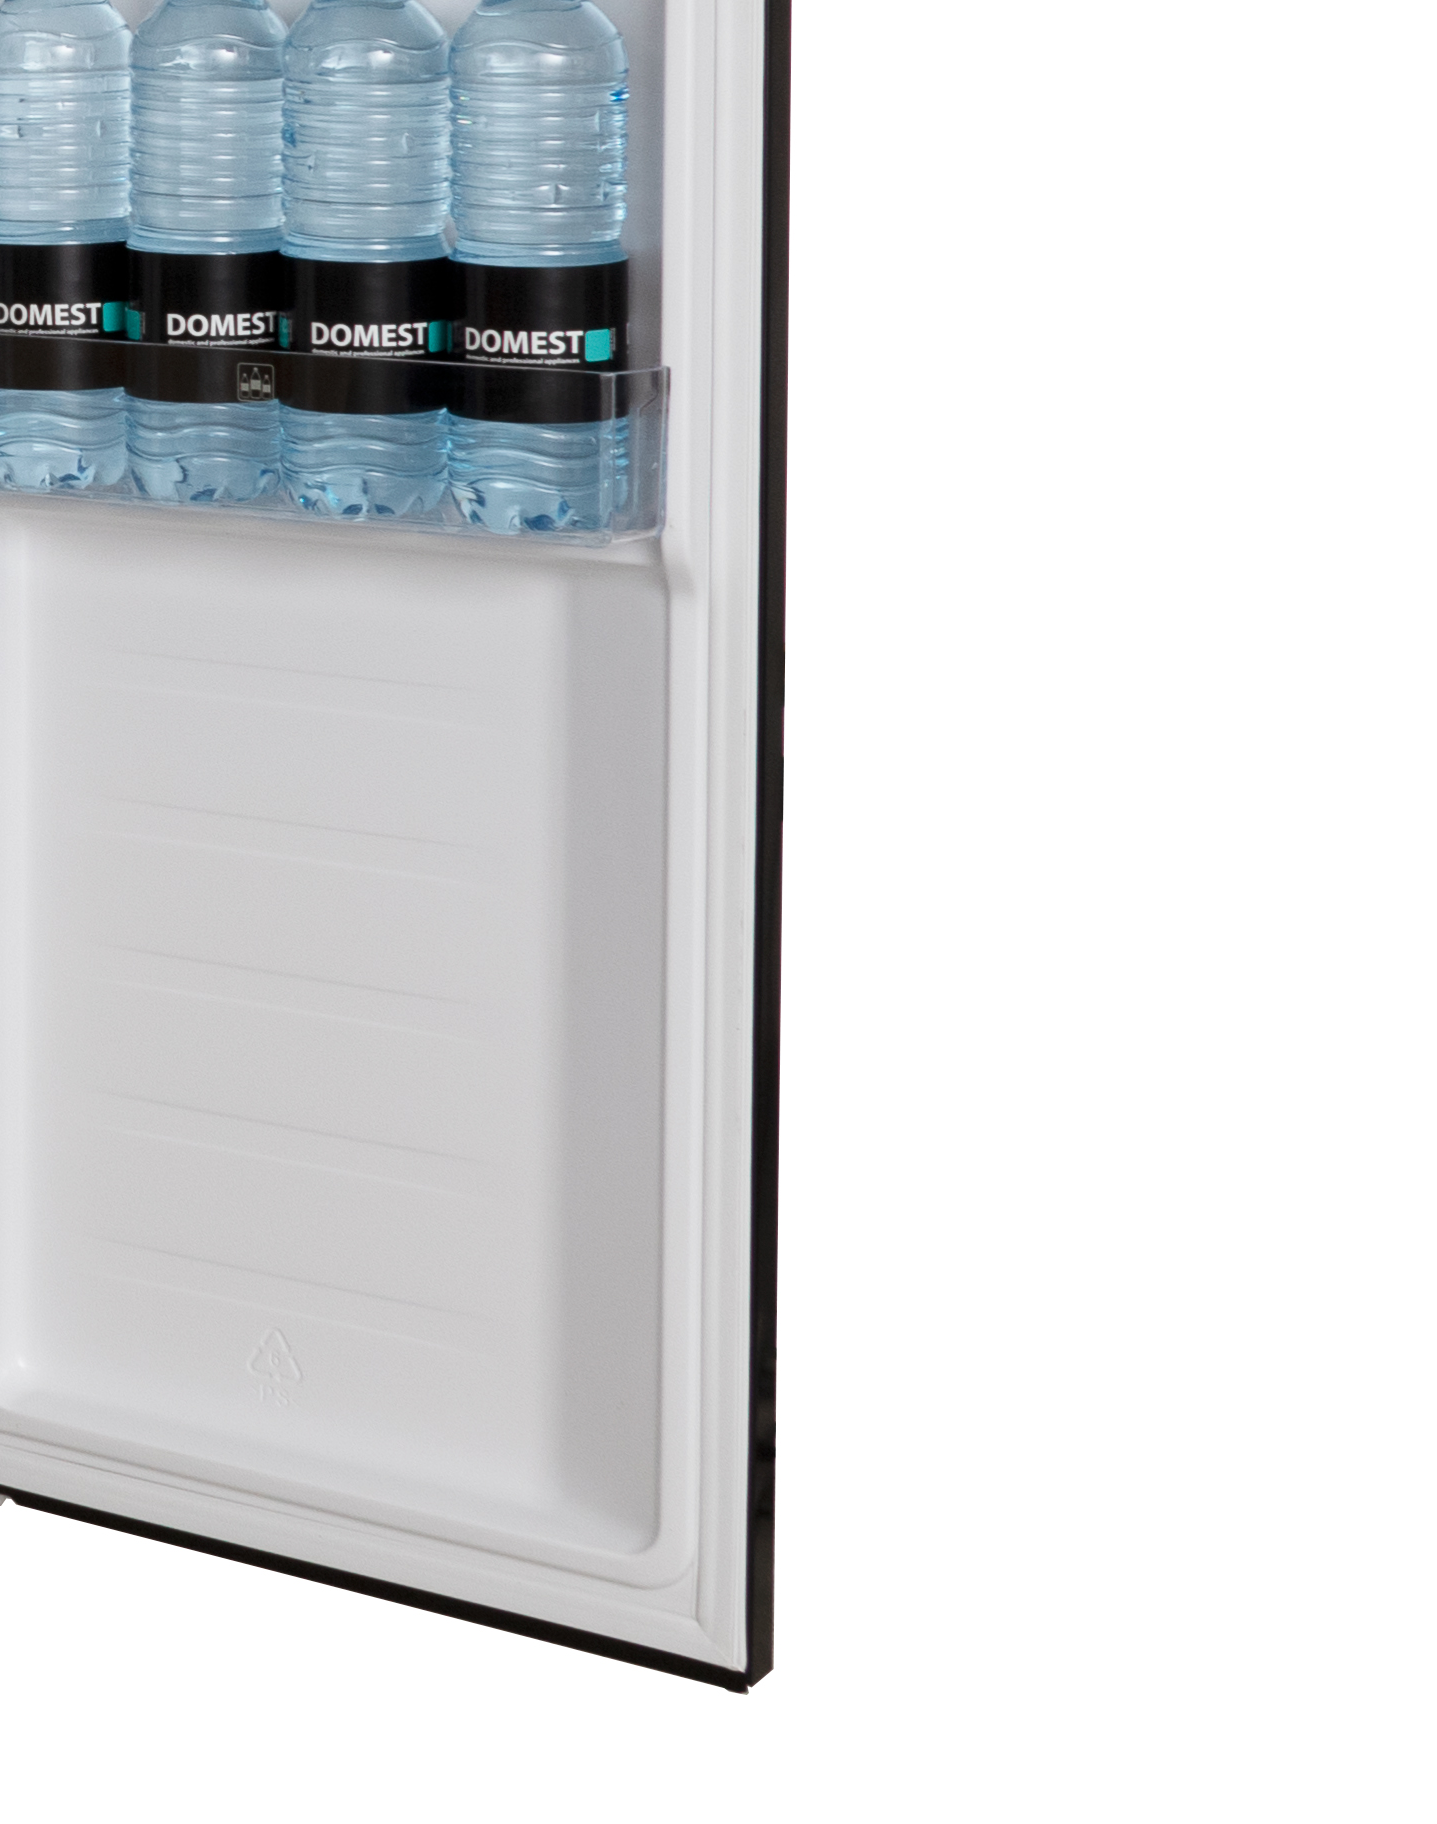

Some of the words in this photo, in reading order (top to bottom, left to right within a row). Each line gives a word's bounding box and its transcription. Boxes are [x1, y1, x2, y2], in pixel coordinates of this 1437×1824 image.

[167, 311, 277, 337] DOMEST
[311, 321, 428, 348] DOMEST
[465, 326, 584, 355] DOMEST
